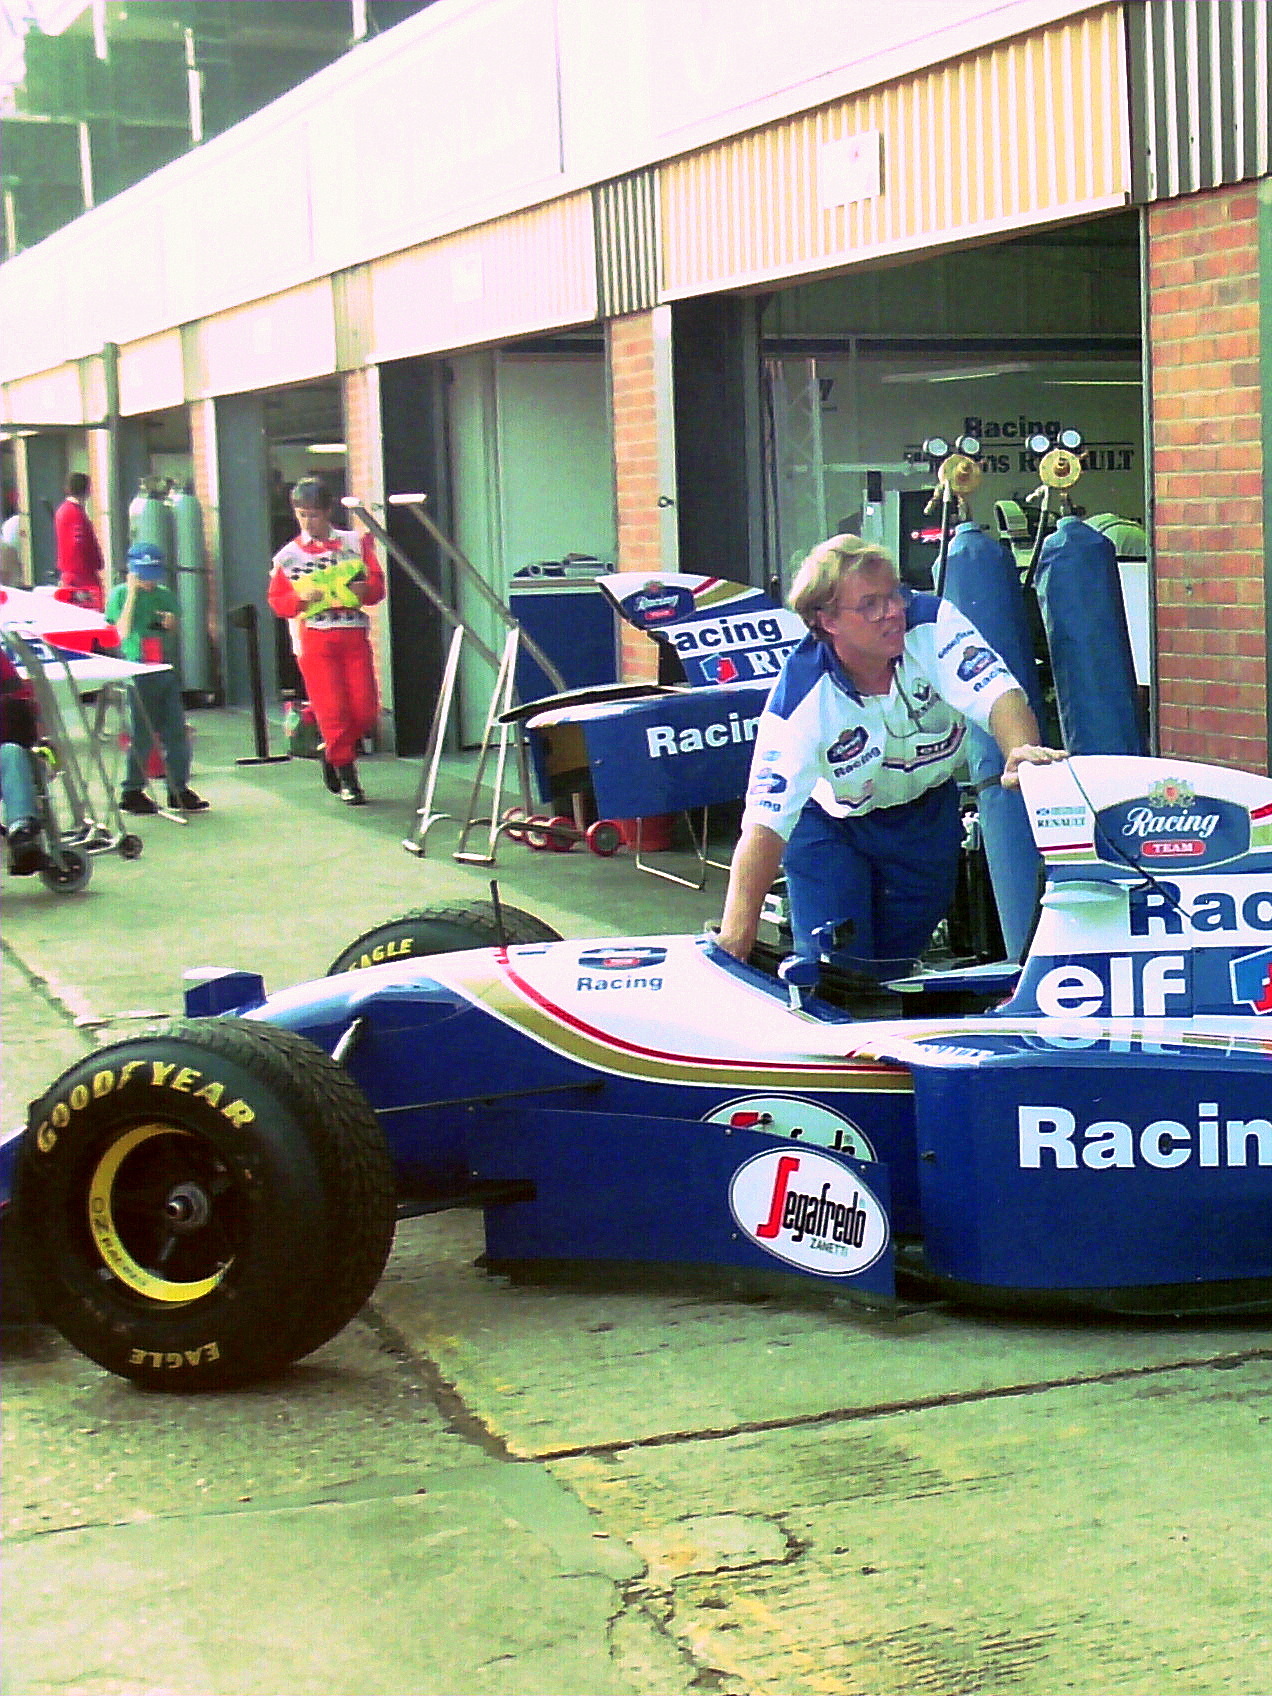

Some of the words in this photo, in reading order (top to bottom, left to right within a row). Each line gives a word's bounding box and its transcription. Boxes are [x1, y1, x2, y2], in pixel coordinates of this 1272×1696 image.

[964, 415, 1061, 439] Racing
[646, 712, 764, 758] Racin
[1121, 807, 1220, 838] Racing
[1152, 842, 1194, 854] TEAM
[576, 975, 663, 992] Racing
[1035, 956, 1185, 1018] elf
[755, 1155, 868, 1249] Segafredo
[128, 1341, 220, 1370] EAGLE
